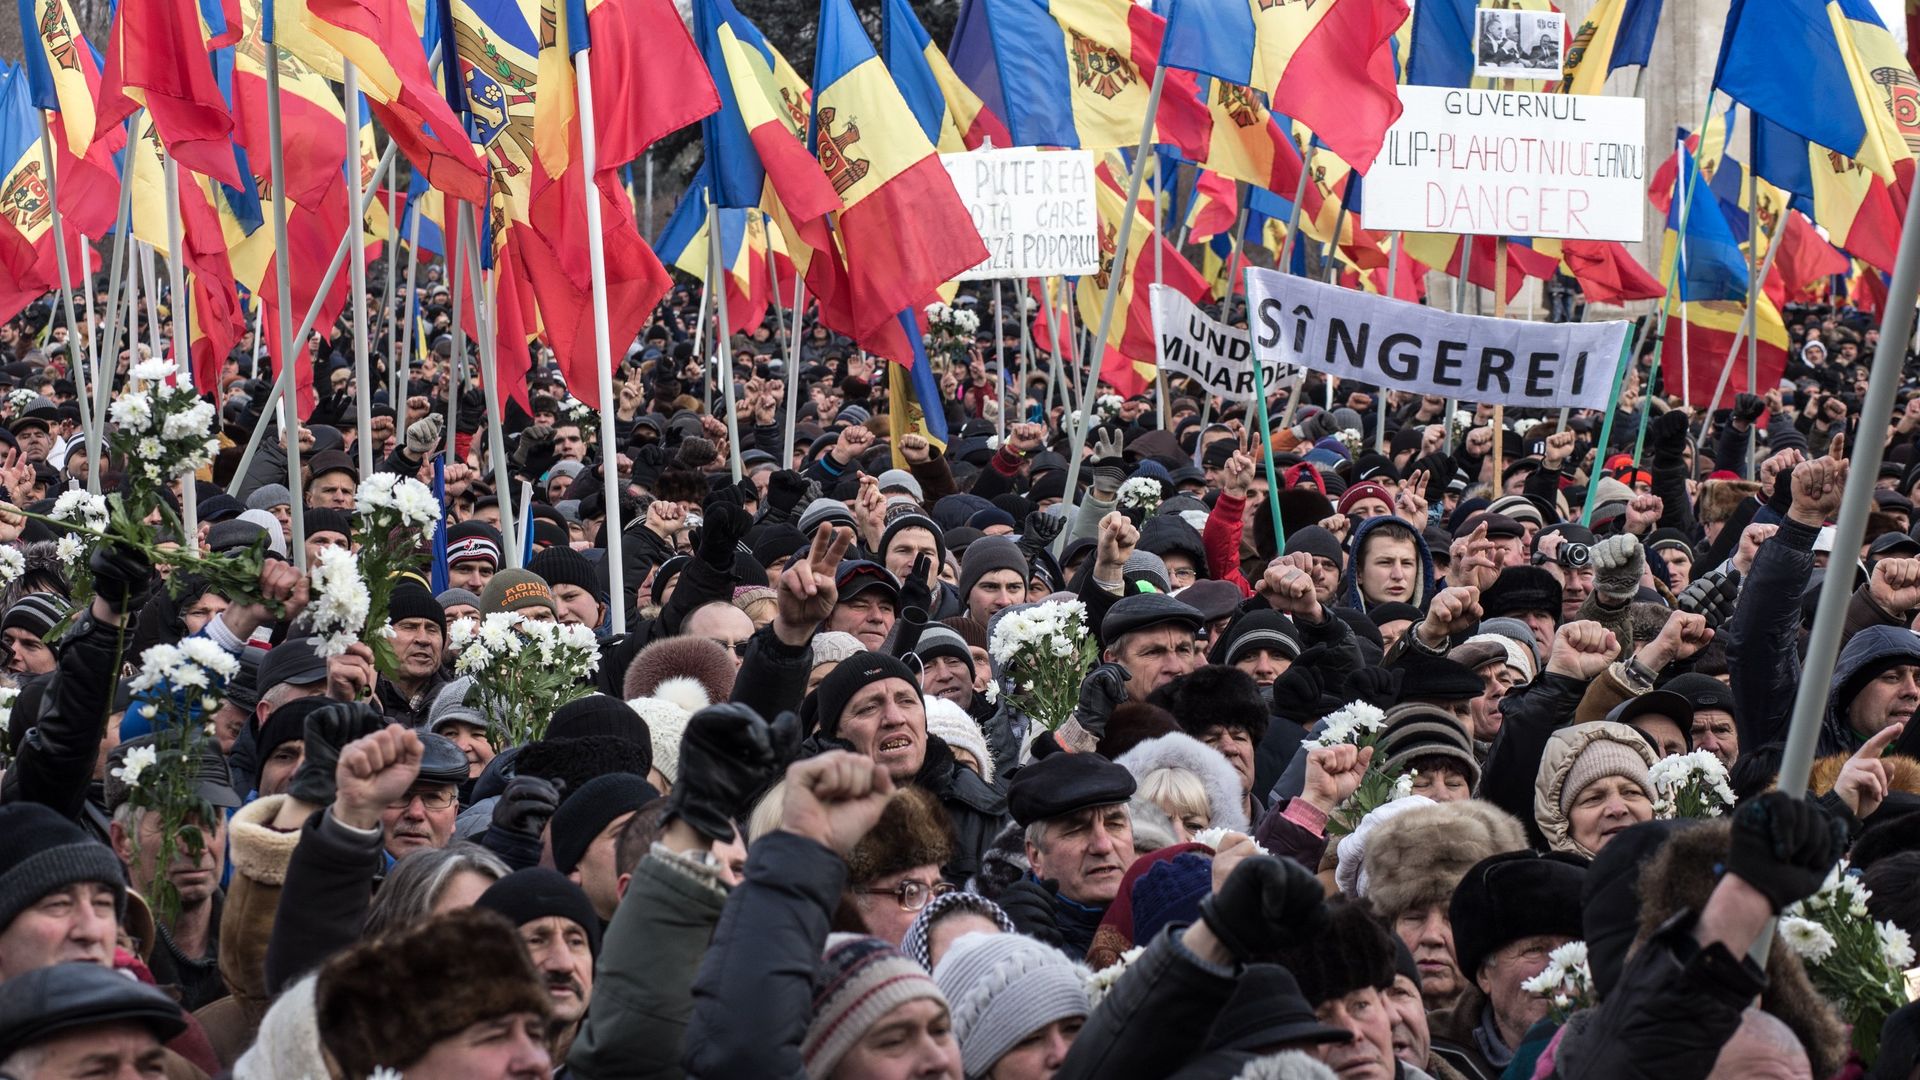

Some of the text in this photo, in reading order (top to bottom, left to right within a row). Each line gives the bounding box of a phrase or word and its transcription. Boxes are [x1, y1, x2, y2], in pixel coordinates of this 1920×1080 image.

[1445, 91, 1586, 121] GUVERNUL
[1373, 130, 1644, 179] ILIP-PLAHOTNIUC-CANDU
[975, 160, 1088, 198] PUTEREA
[971, 199, 1087, 231] OTA CARE
[1426, 181, 1590, 235] DANGER
[1023, 234, 1099, 269] POPORUL
[1189, 314, 1251, 363] UND
